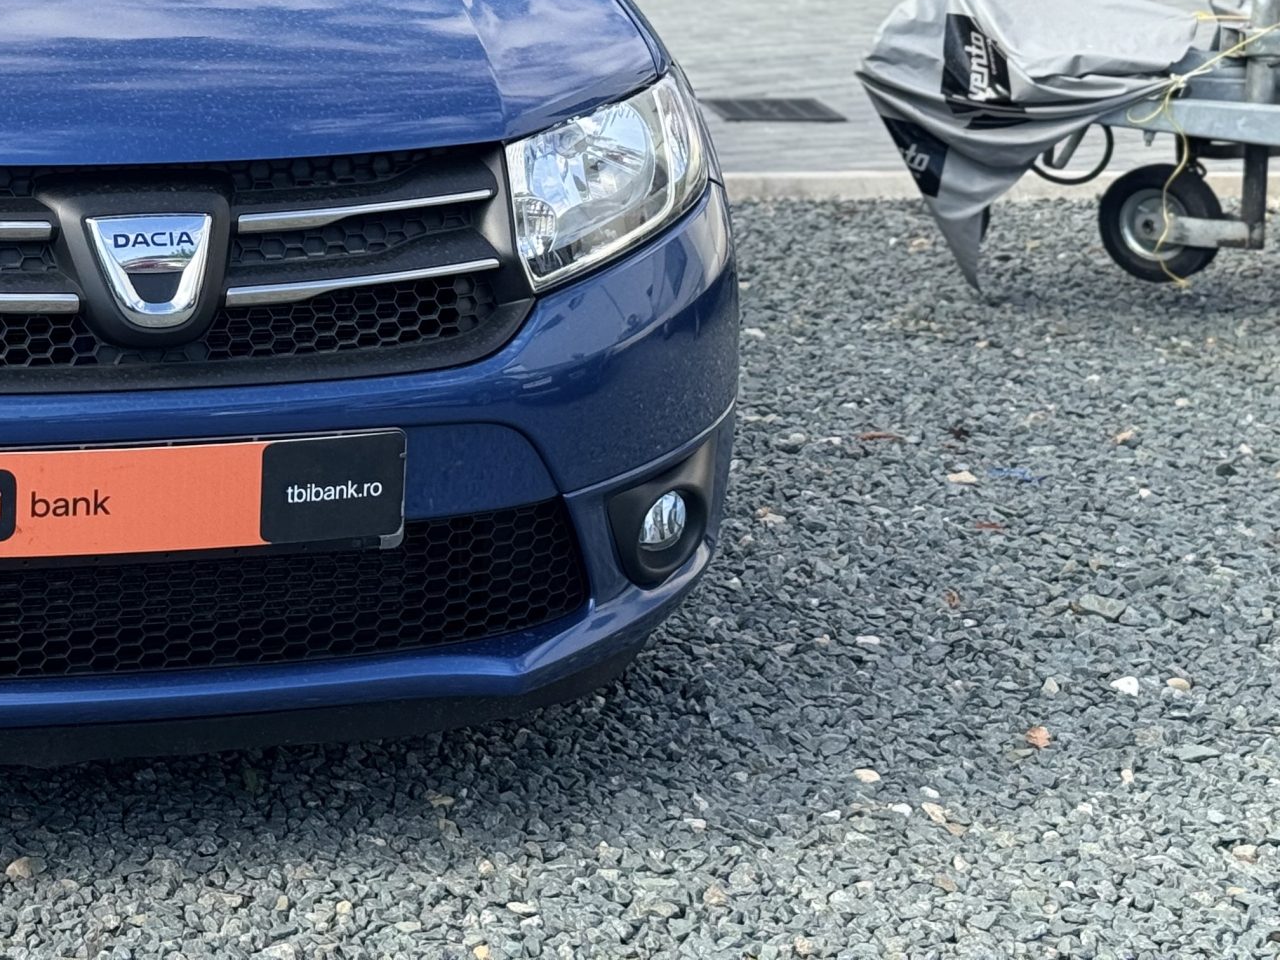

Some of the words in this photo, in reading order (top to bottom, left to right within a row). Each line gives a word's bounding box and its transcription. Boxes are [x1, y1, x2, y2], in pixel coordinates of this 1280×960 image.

[113, 231, 194, 248] DACIA
[31, 489, 111, 518] bank
[286, 480, 383, 503] tbibank.ro
